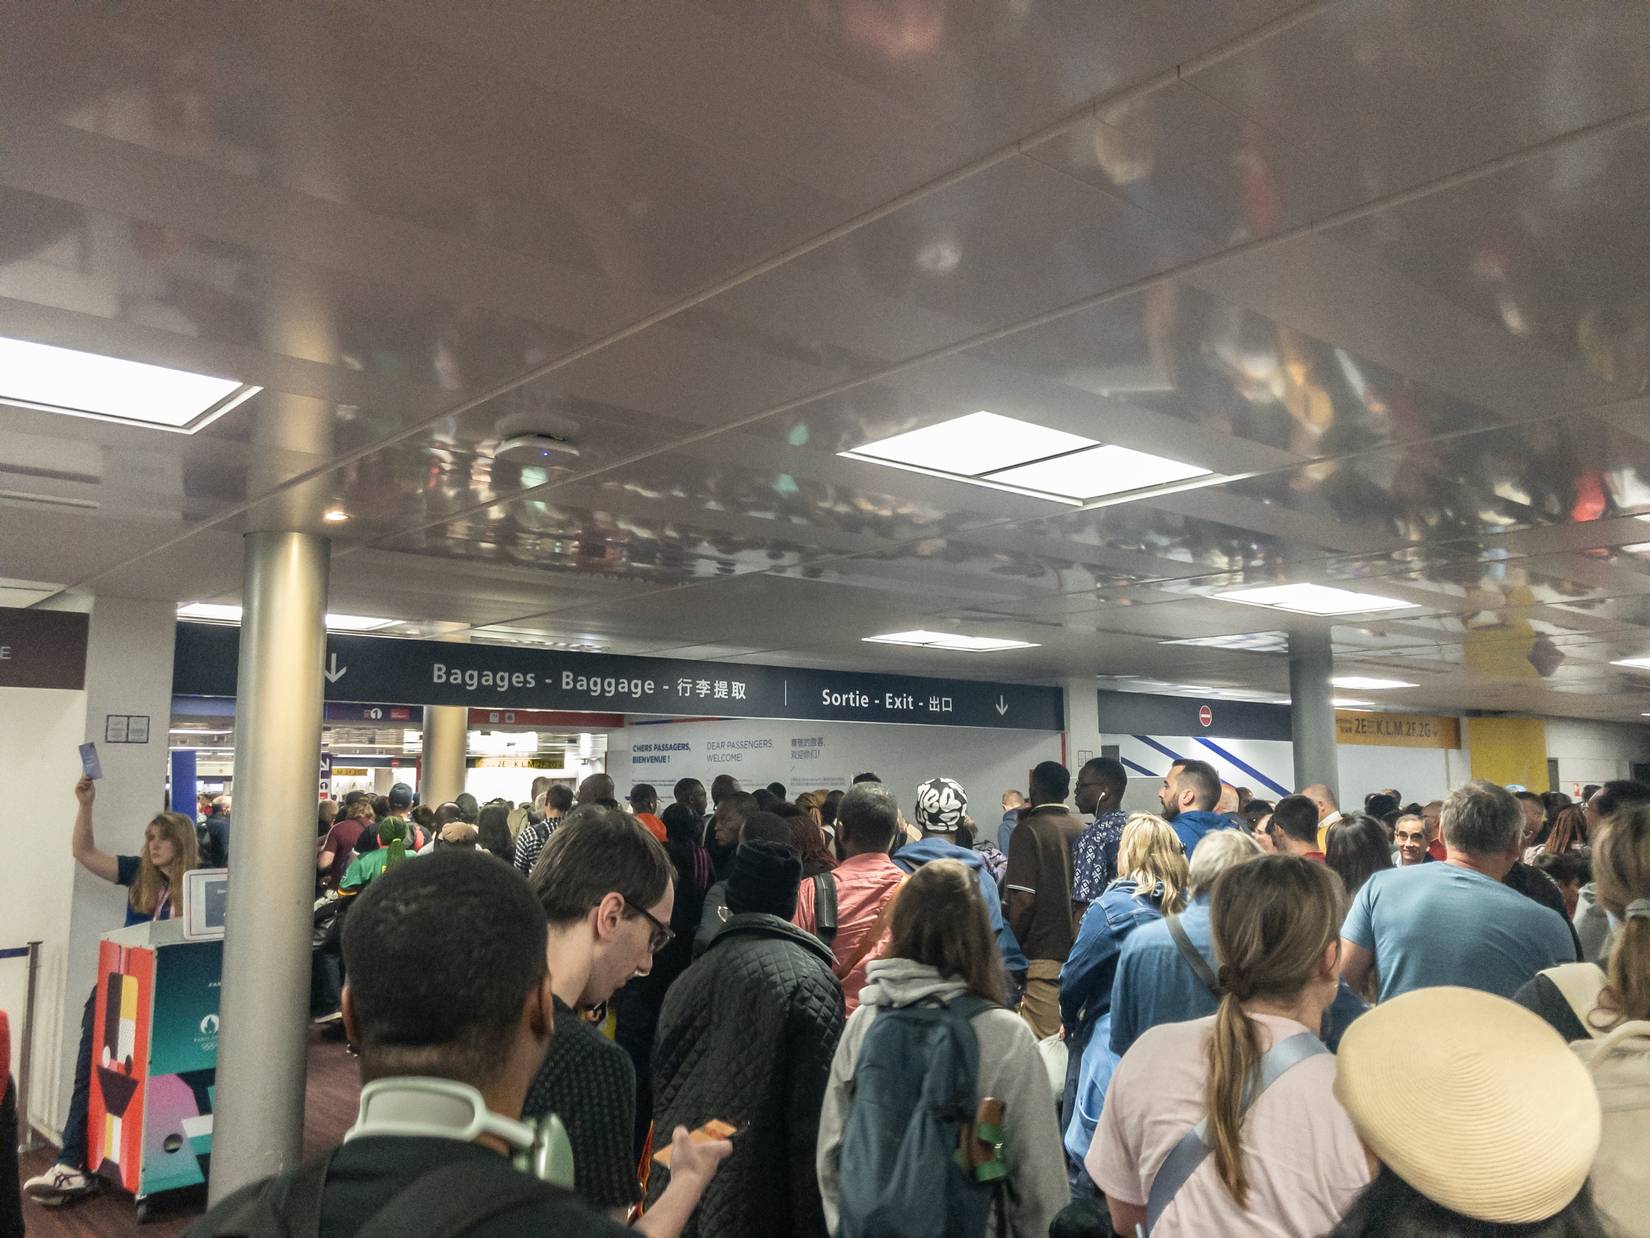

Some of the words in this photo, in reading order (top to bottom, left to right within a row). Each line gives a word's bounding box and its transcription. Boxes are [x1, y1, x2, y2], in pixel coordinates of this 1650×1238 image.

[433, 663, 536, 691] Bagages
[562, 671, 655, 698] Baggage
[677, 678, 747, 700] 行李提取
[822, 688, 869, 708] Sortie
[885, 693, 914, 710] Exit
[929, 695, 953, 713] 出口
[1355, 718, 1367, 734] 2E
[632, 744, 653, 752] CHERS
[653, 742, 691, 752] PASSAGERS,
[706, 740, 725, 750] DEAR
[632, 755, 667, 764] BIENVENUE
